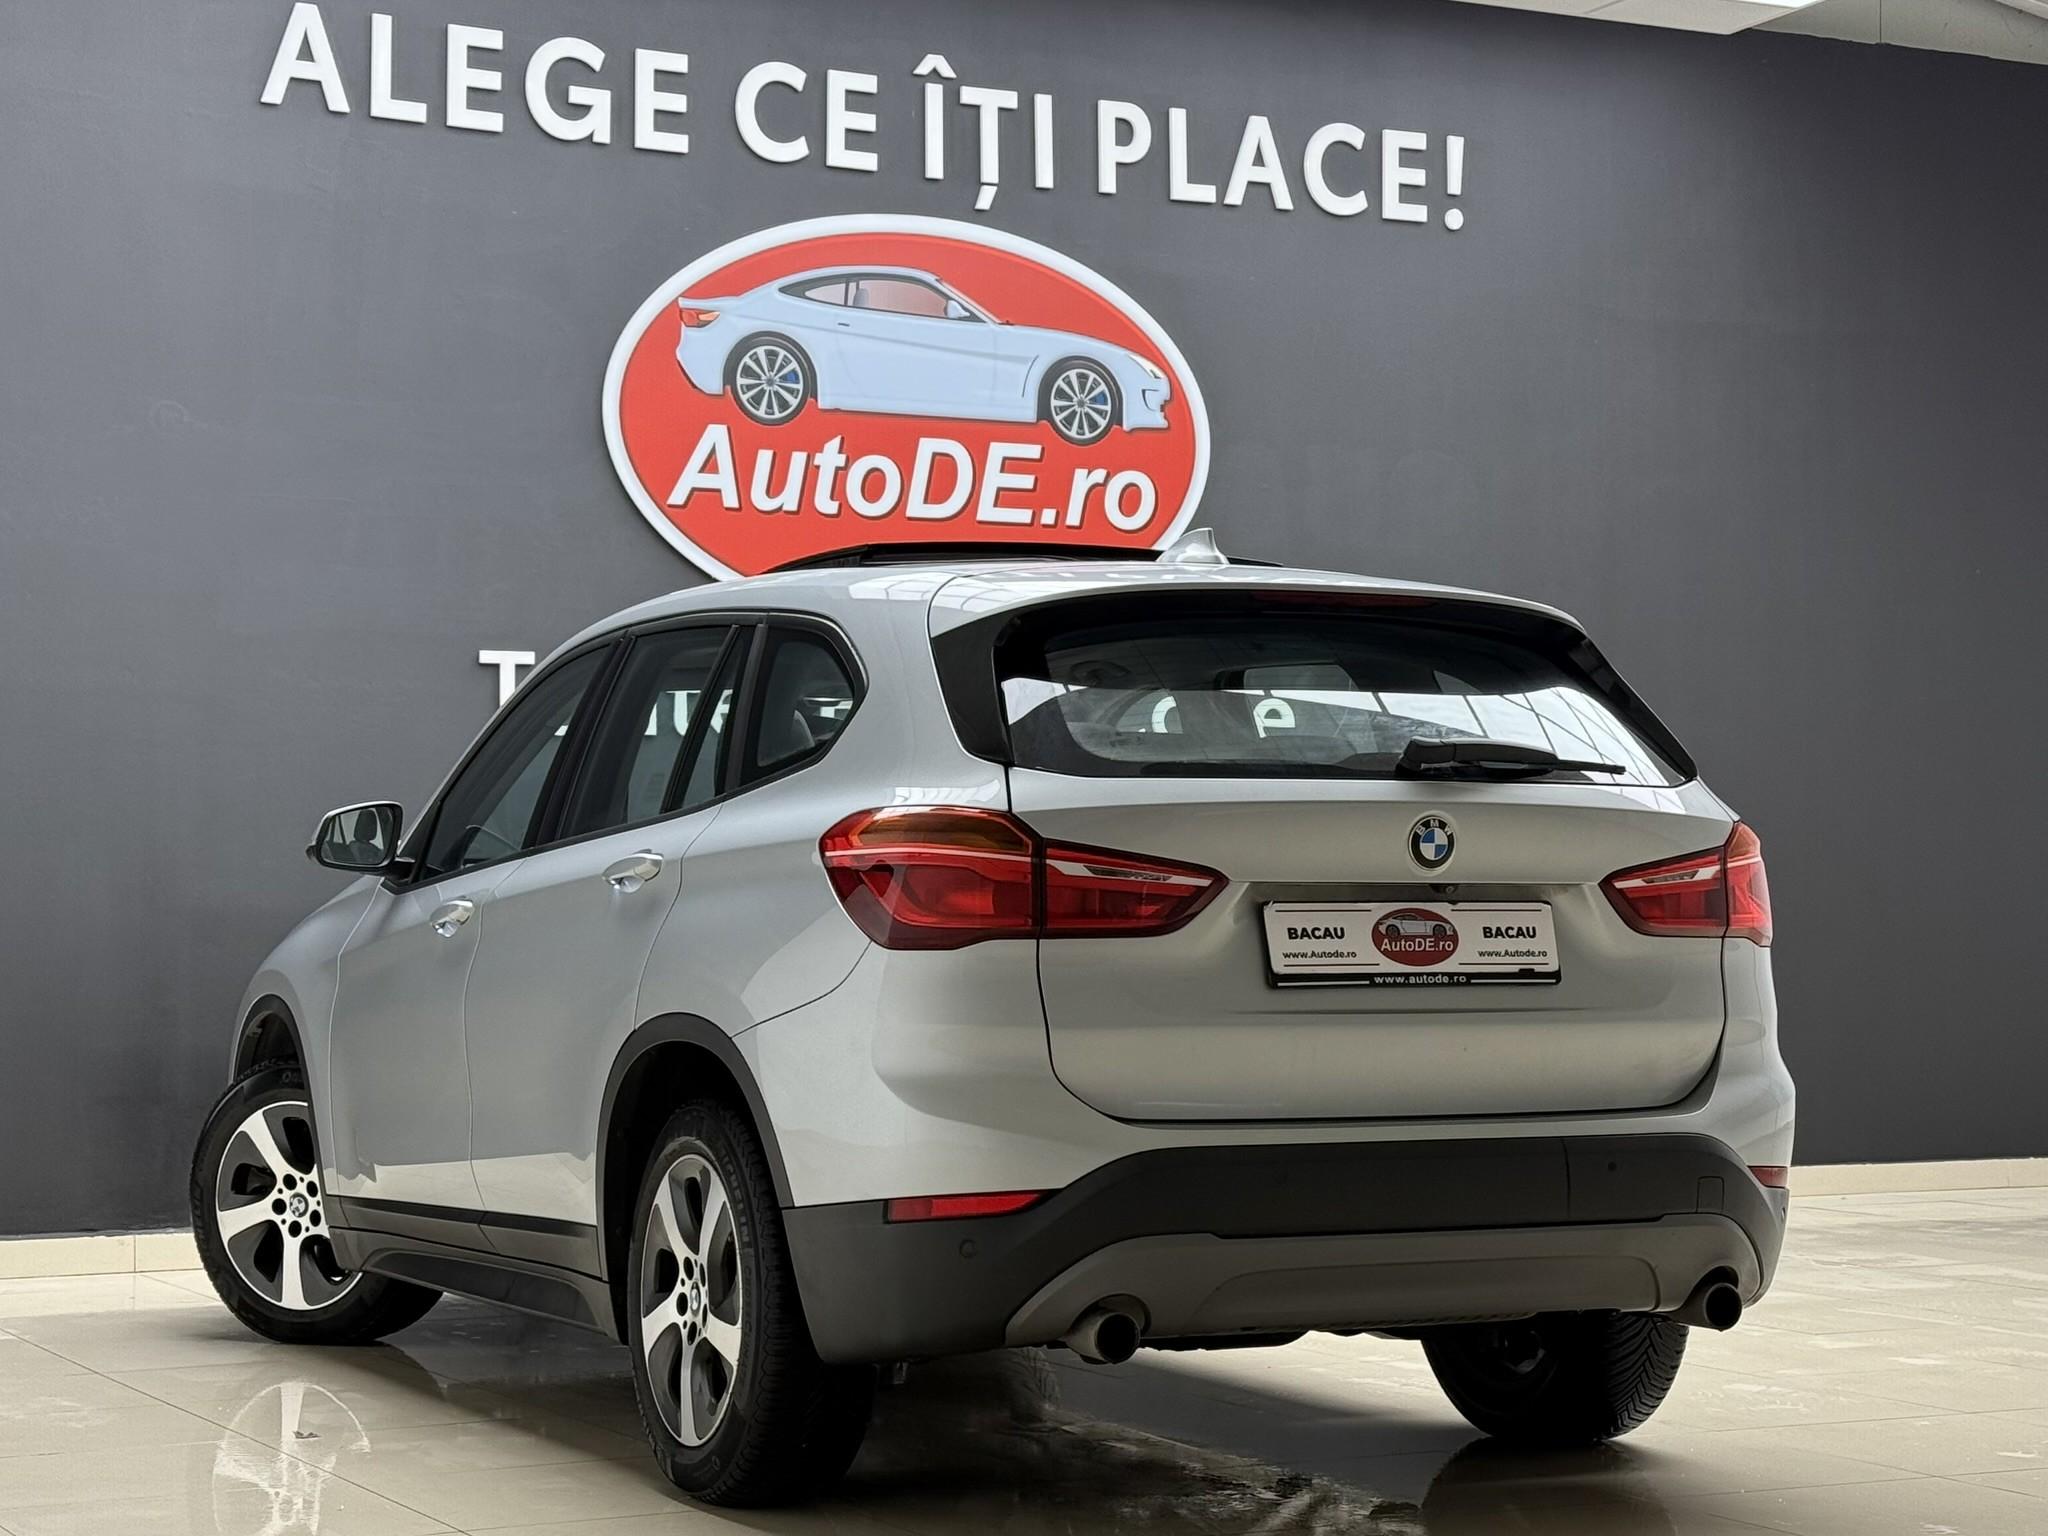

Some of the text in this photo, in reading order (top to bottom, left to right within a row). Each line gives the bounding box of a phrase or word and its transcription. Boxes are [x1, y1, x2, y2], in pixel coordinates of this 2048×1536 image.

[260, 2, 1465, 231] ALEGE CE ÎȚI PLACE!
[667, 423, 1157, 532] AutoDE.ro
[1415, 819, 1454, 836] BMW
[1286, 926, 1346, 941] BACAU
[1482, 925, 1537, 940] BACAU
[1380, 937, 1454, 952] AutoDE.ro
[1282, 949, 1357, 960] www.Autode.ro
[1477, 948, 1548, 959] www.Autode.ro
[1374, 973, 1467, 985] www.autode.ro
